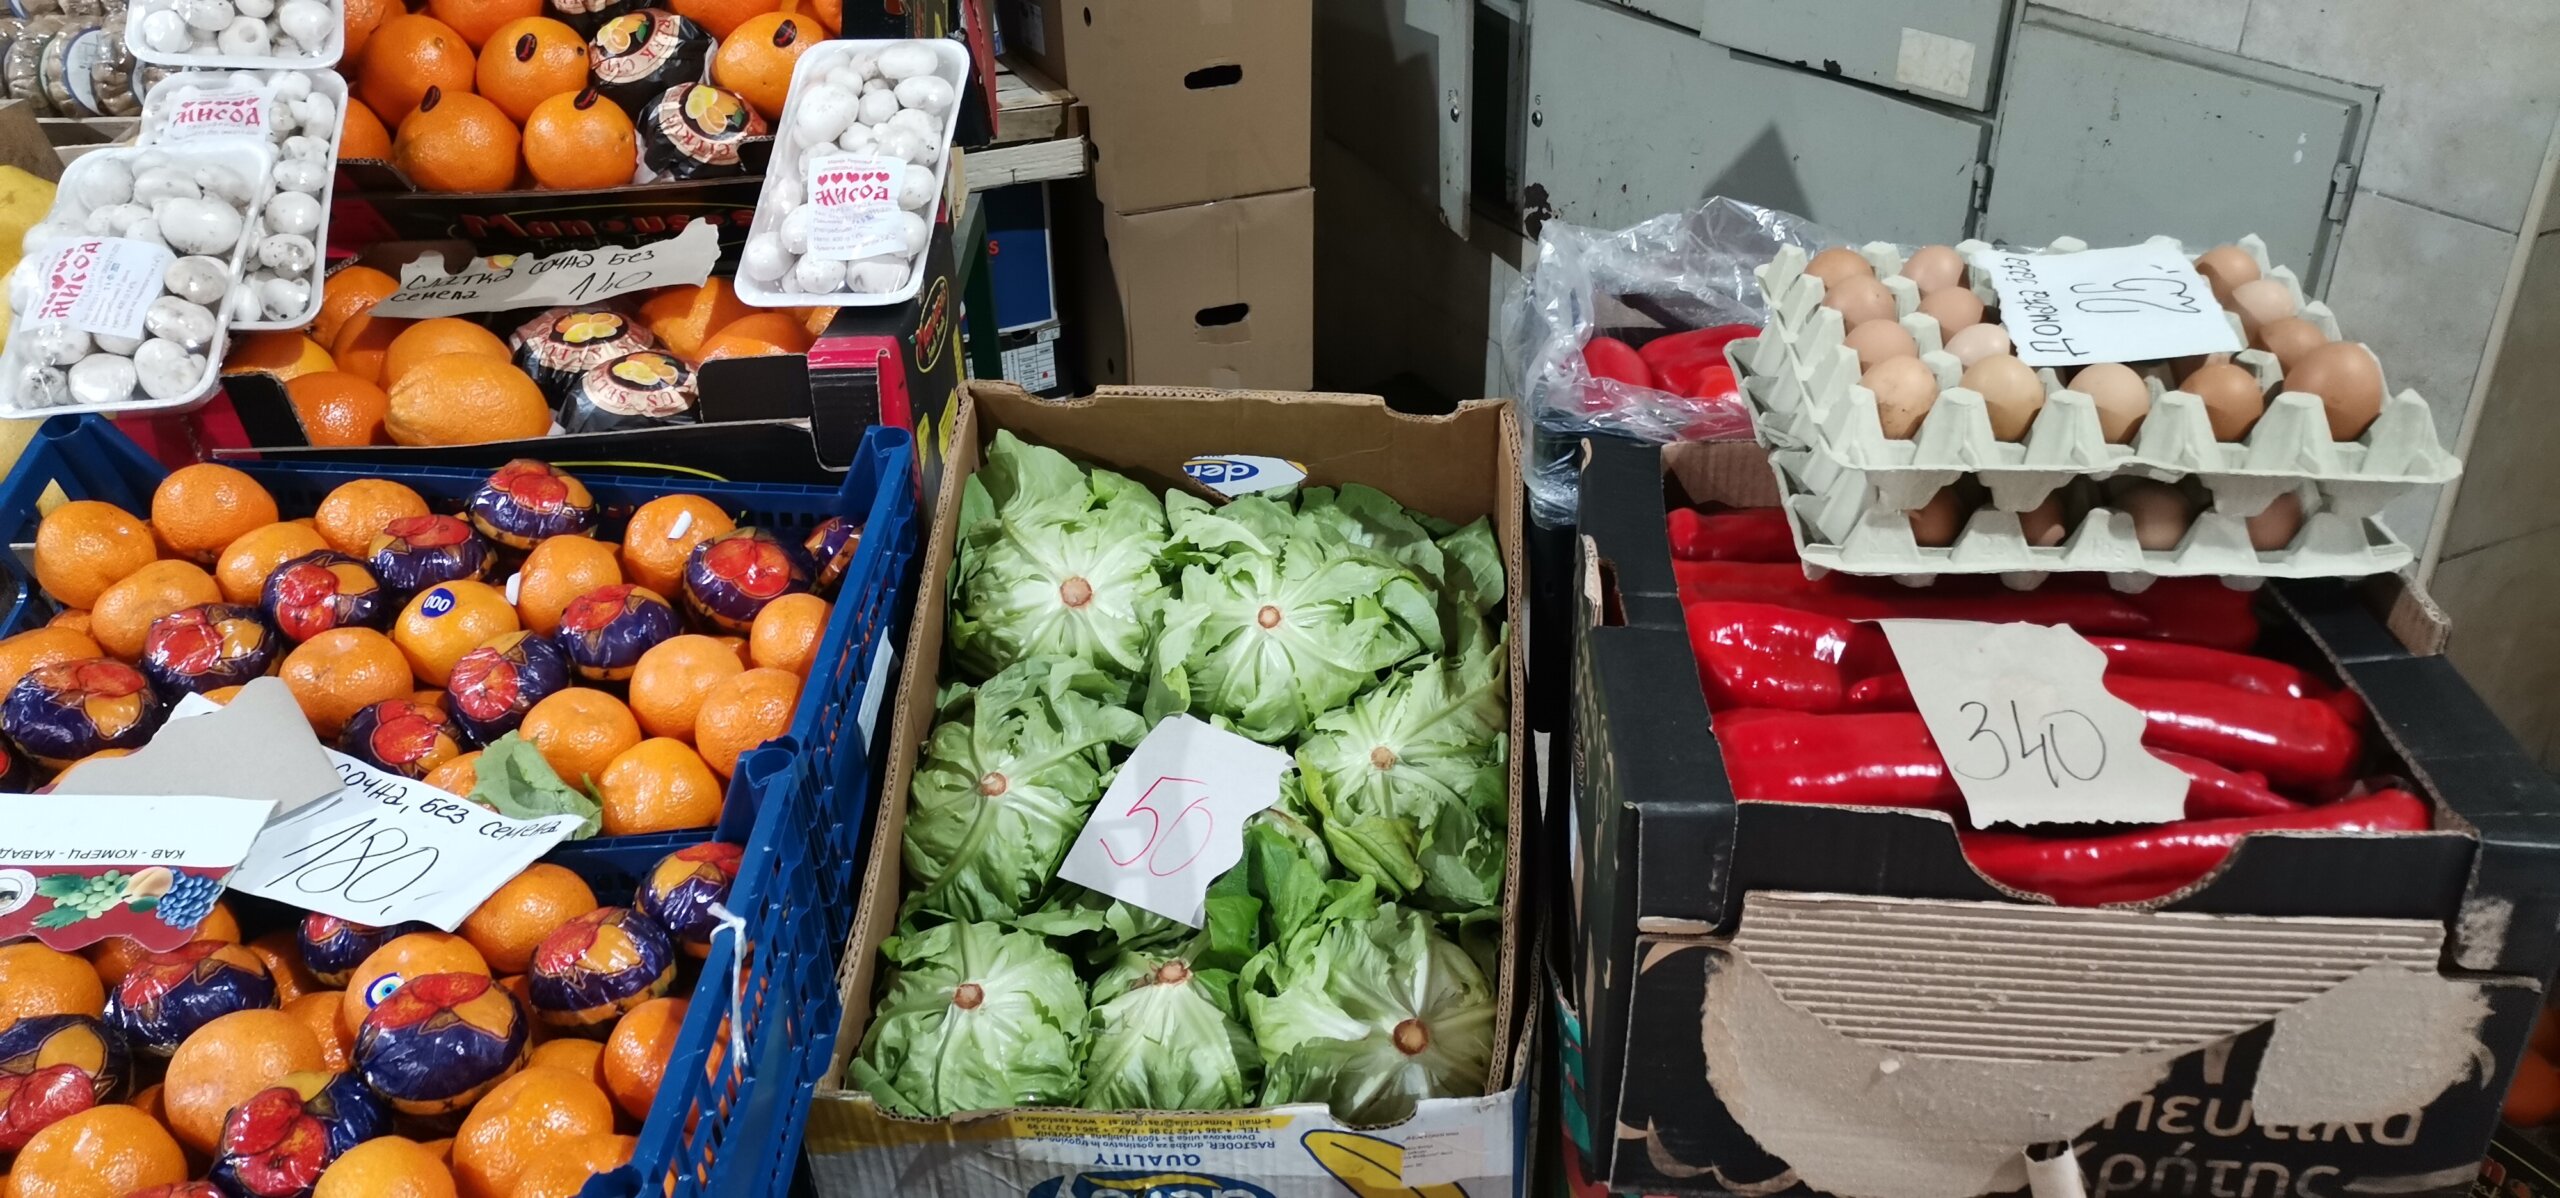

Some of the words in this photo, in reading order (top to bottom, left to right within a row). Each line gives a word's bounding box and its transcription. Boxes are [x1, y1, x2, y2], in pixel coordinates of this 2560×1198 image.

[1534, 94, 1541, 106] 6
[568, 271, 653, 301] 140
[1954, 700, 2106, 788] 340
[1100, 776, 1213, 877] 50
[67, 847, 138, 860] КОМЕРЦ
[151, 848, 186, 860] КАВ
[1094, 1152, 1201, 1167] QUALITY
